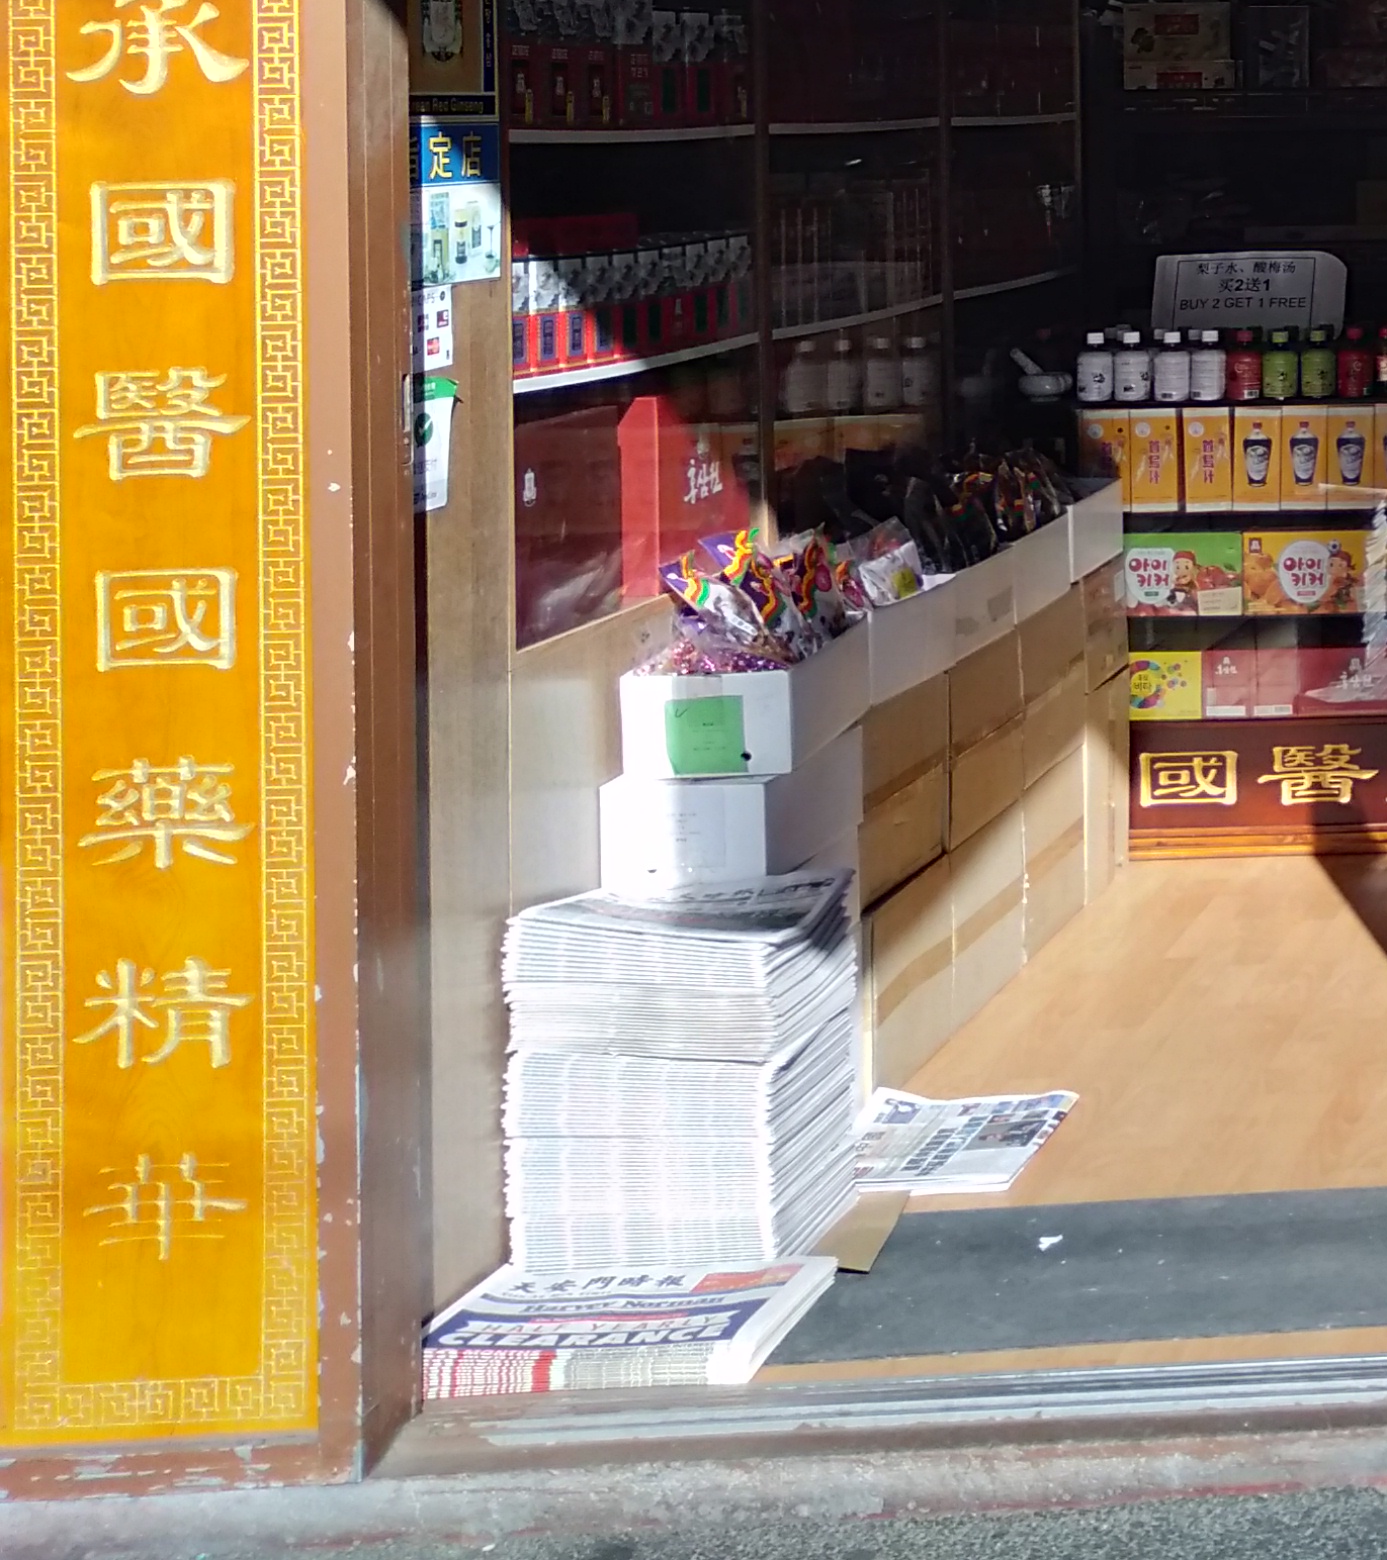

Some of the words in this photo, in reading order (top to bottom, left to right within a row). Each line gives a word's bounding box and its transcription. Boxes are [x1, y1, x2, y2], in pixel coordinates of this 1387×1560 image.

[450, 98, 485, 115] Ginseng
[1218, 278, 1271, 293] 买2送1
[1180, 299, 1209, 310] BUY
[1212, 298, 1219, 309] 2
[1224, 297, 1252, 309] GET
[1259, 299, 1263, 308] 1
[1269, 297, 1306, 308] FREE
[1128, 557, 1167, 571] 아이
[1283, 557, 1322, 572] 아이
[1136, 572, 1169, 587] 키커
[1291, 571, 1324, 587] 키커
[519, 1299, 618, 1314] Harvey
[624, 1296, 726, 1309] Norman
[480, 1320, 570, 1334] HALF
[590, 1313, 721, 1331] YEARLY
[438, 1325, 729, 1347] CLEARANCE
